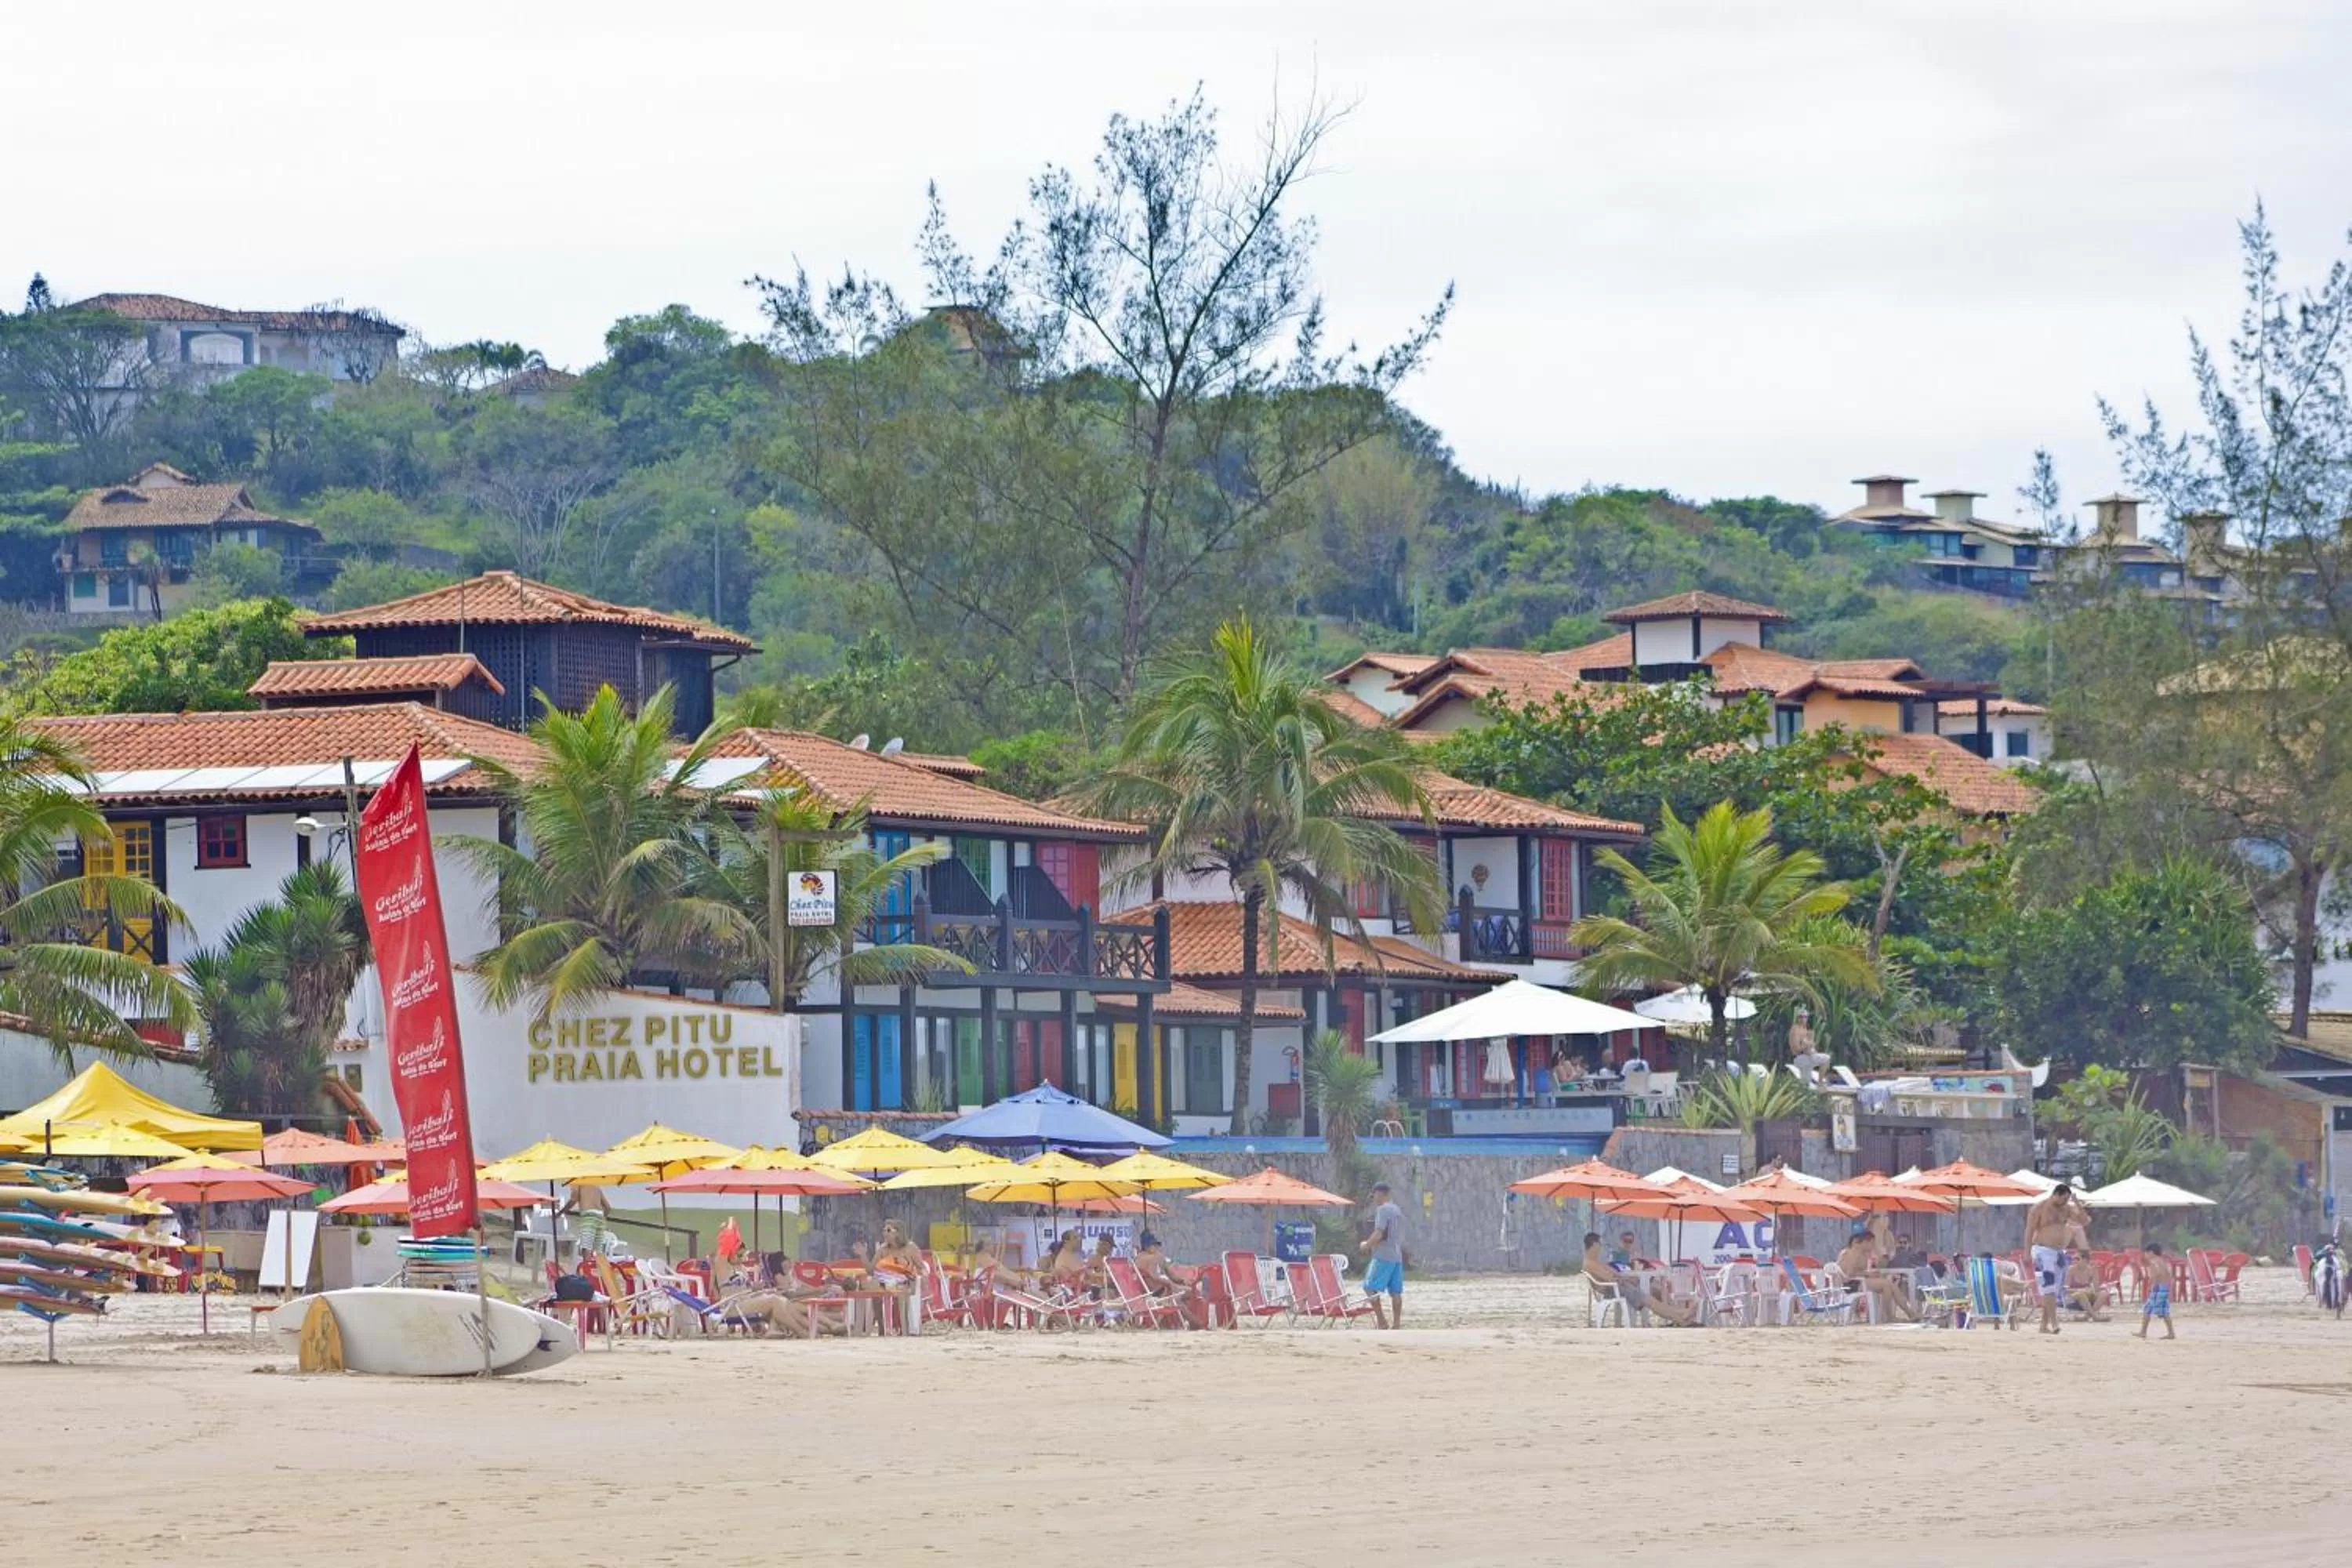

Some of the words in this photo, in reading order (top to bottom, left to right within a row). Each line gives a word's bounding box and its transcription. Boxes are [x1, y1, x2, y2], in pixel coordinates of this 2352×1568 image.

[528, 1016, 631, 1050] CHEZ
[644, 1014, 731, 1046] PITU
[528, 1048, 643, 1083] PRAIA
[655, 1046, 782, 1080] HOTEL
